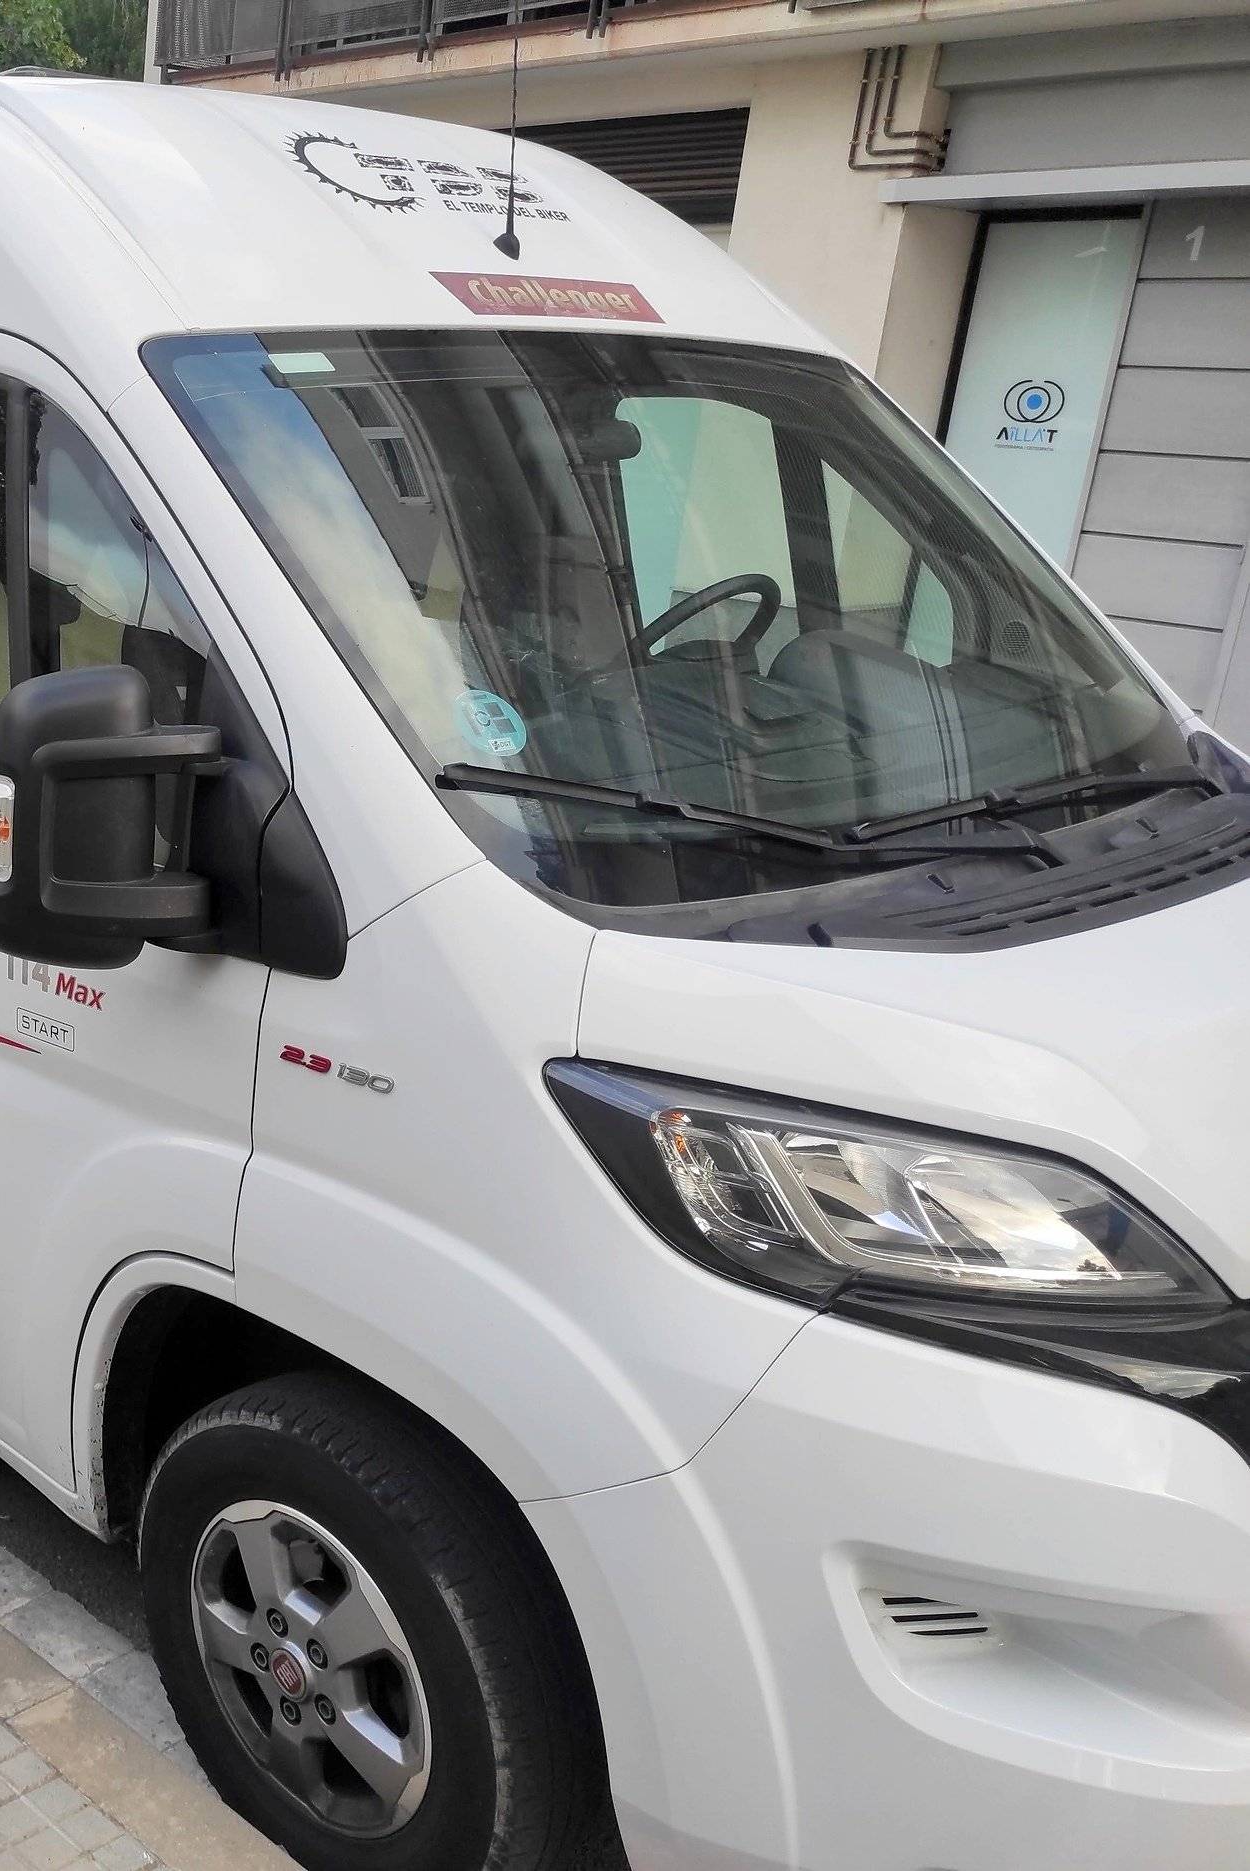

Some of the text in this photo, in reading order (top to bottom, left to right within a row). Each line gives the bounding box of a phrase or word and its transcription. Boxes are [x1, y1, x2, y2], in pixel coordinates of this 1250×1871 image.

[443, 199, 461, 212] EL
[535, 208, 571, 222] BIKER
[1185, 225, 1205, 261] 1
[54, 972, 107, 1012] Max
[21, 1015, 69, 1043] START
[279, 1045, 332, 1074] 2.3
